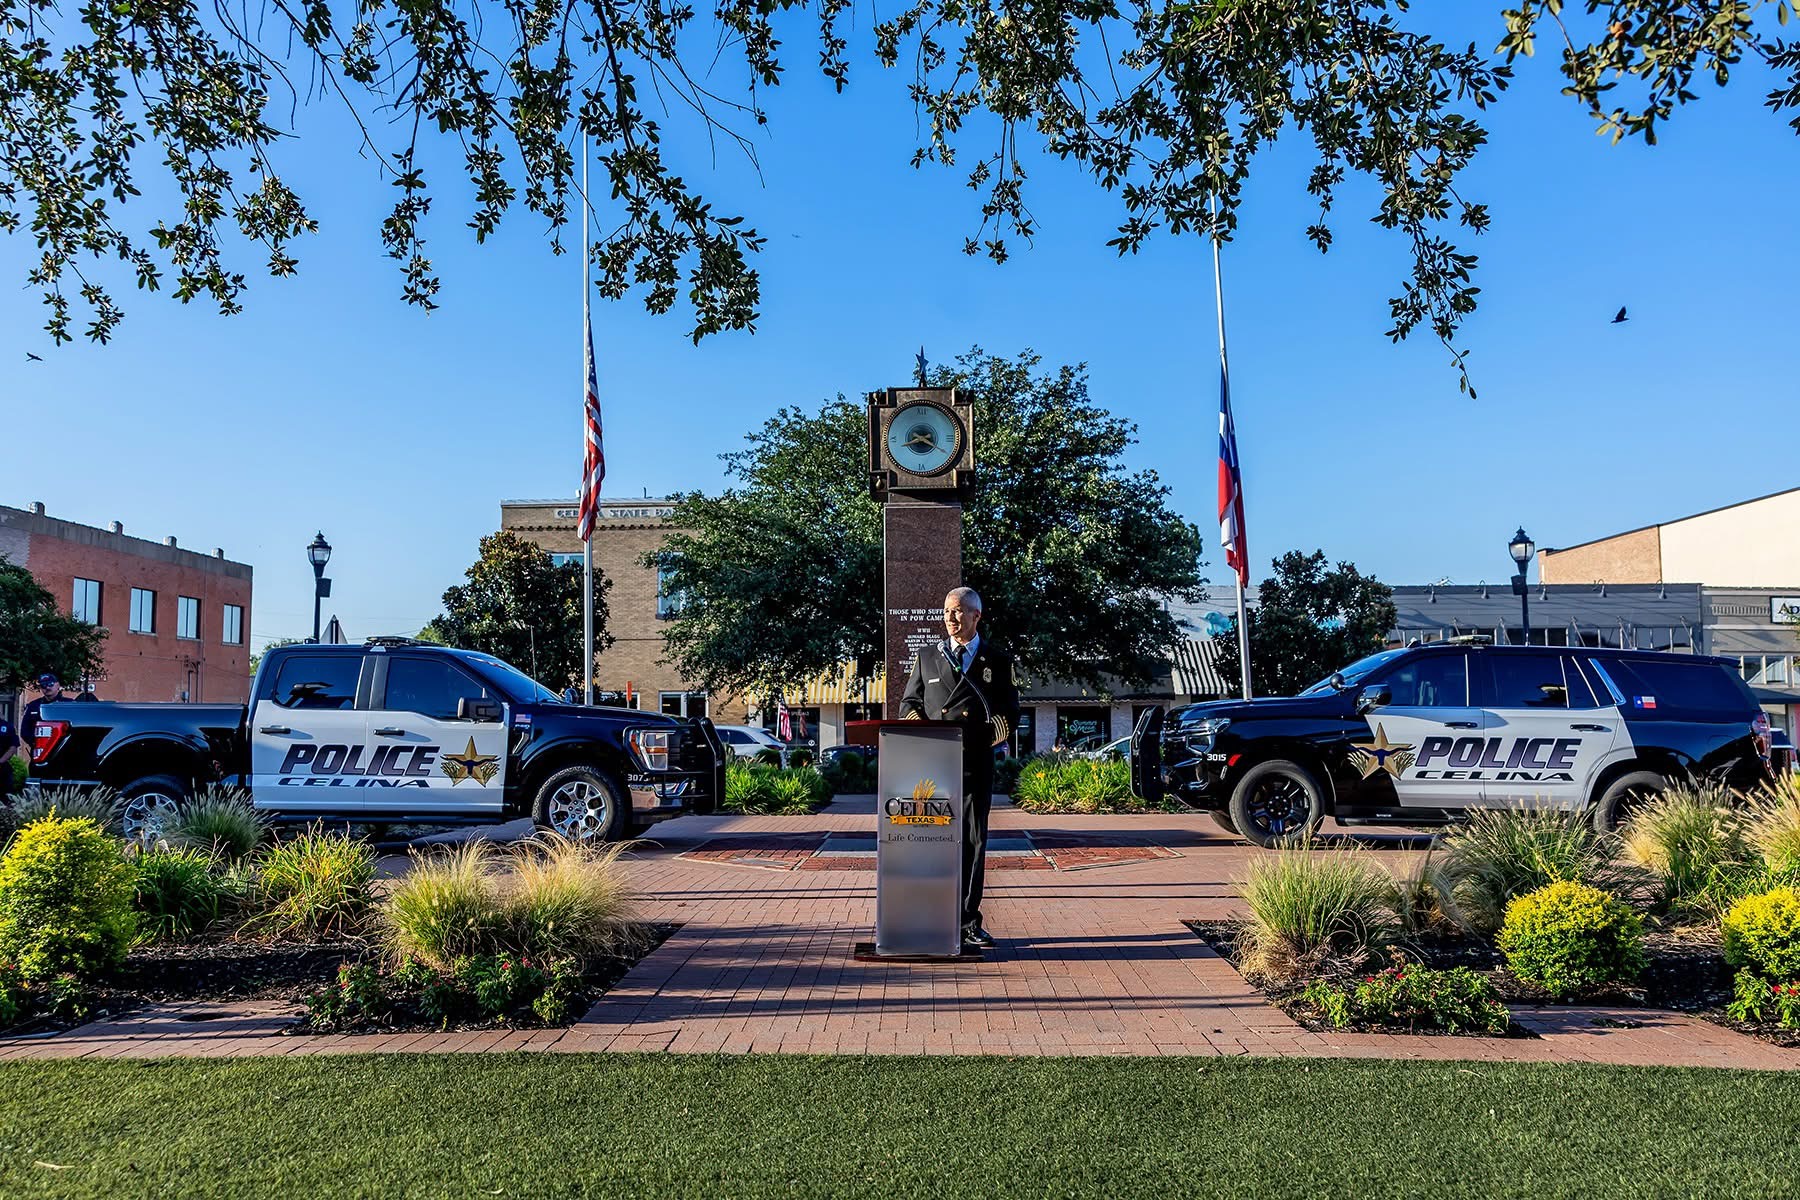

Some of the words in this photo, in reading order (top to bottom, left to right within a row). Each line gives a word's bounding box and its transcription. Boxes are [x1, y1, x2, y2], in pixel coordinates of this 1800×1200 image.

[609, 509, 650, 518] STATE
[1206, 753, 1227, 761] 3015
[1415, 736, 1582, 769] POLICE
[279, 743, 440, 777] POLICE
[1415, 770, 1574, 782] CELINA
[278, 777, 430, 788] CELINA
[884, 797, 955, 817] CELINA
[888, 833, 905, 842] Life
[908, 833, 956, 842] Connected.
